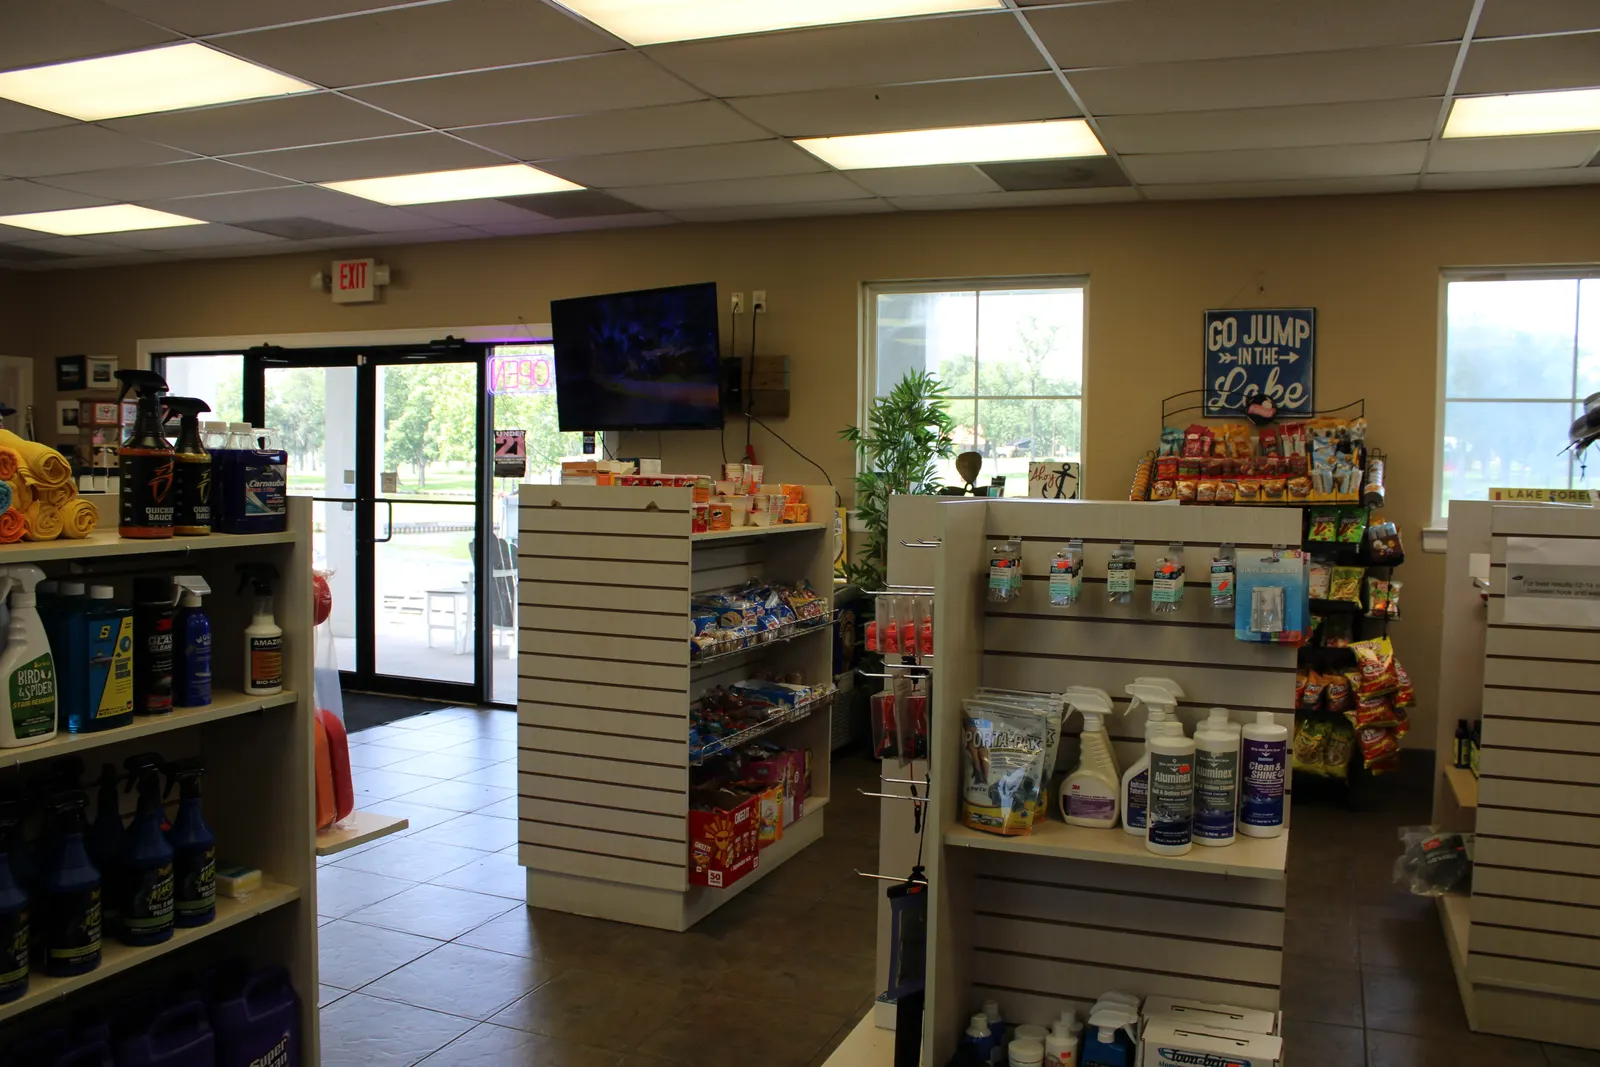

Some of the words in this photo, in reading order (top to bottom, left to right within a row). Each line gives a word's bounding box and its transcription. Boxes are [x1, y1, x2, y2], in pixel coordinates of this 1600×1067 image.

[340, 262, 368, 290] EXIT
[1208, 316, 1238, 351] GO
[1243, 314, 1310, 348] JUMP
[1238, 347, 1252, 365] IN
[1254, 347, 1279, 365] THE
[496, 436, 526, 457] 21
[1030, 465, 1057, 489] Ahoy
[1508, 490, 1542, 499] LAKE
[18, 669, 41, 686] BIRD
[24, 681, 53, 701] SPIDER
[965, 730, 1042, 751] PORTA-PAK
[1196, 766, 1233, 778] Aluminex
[1249, 761, 1275, 771] Clean
[1275, 763, 1281, 771] &
[1250, 770, 1278, 780] SHINE
[1155, 772, 1191, 783] Aluminex
